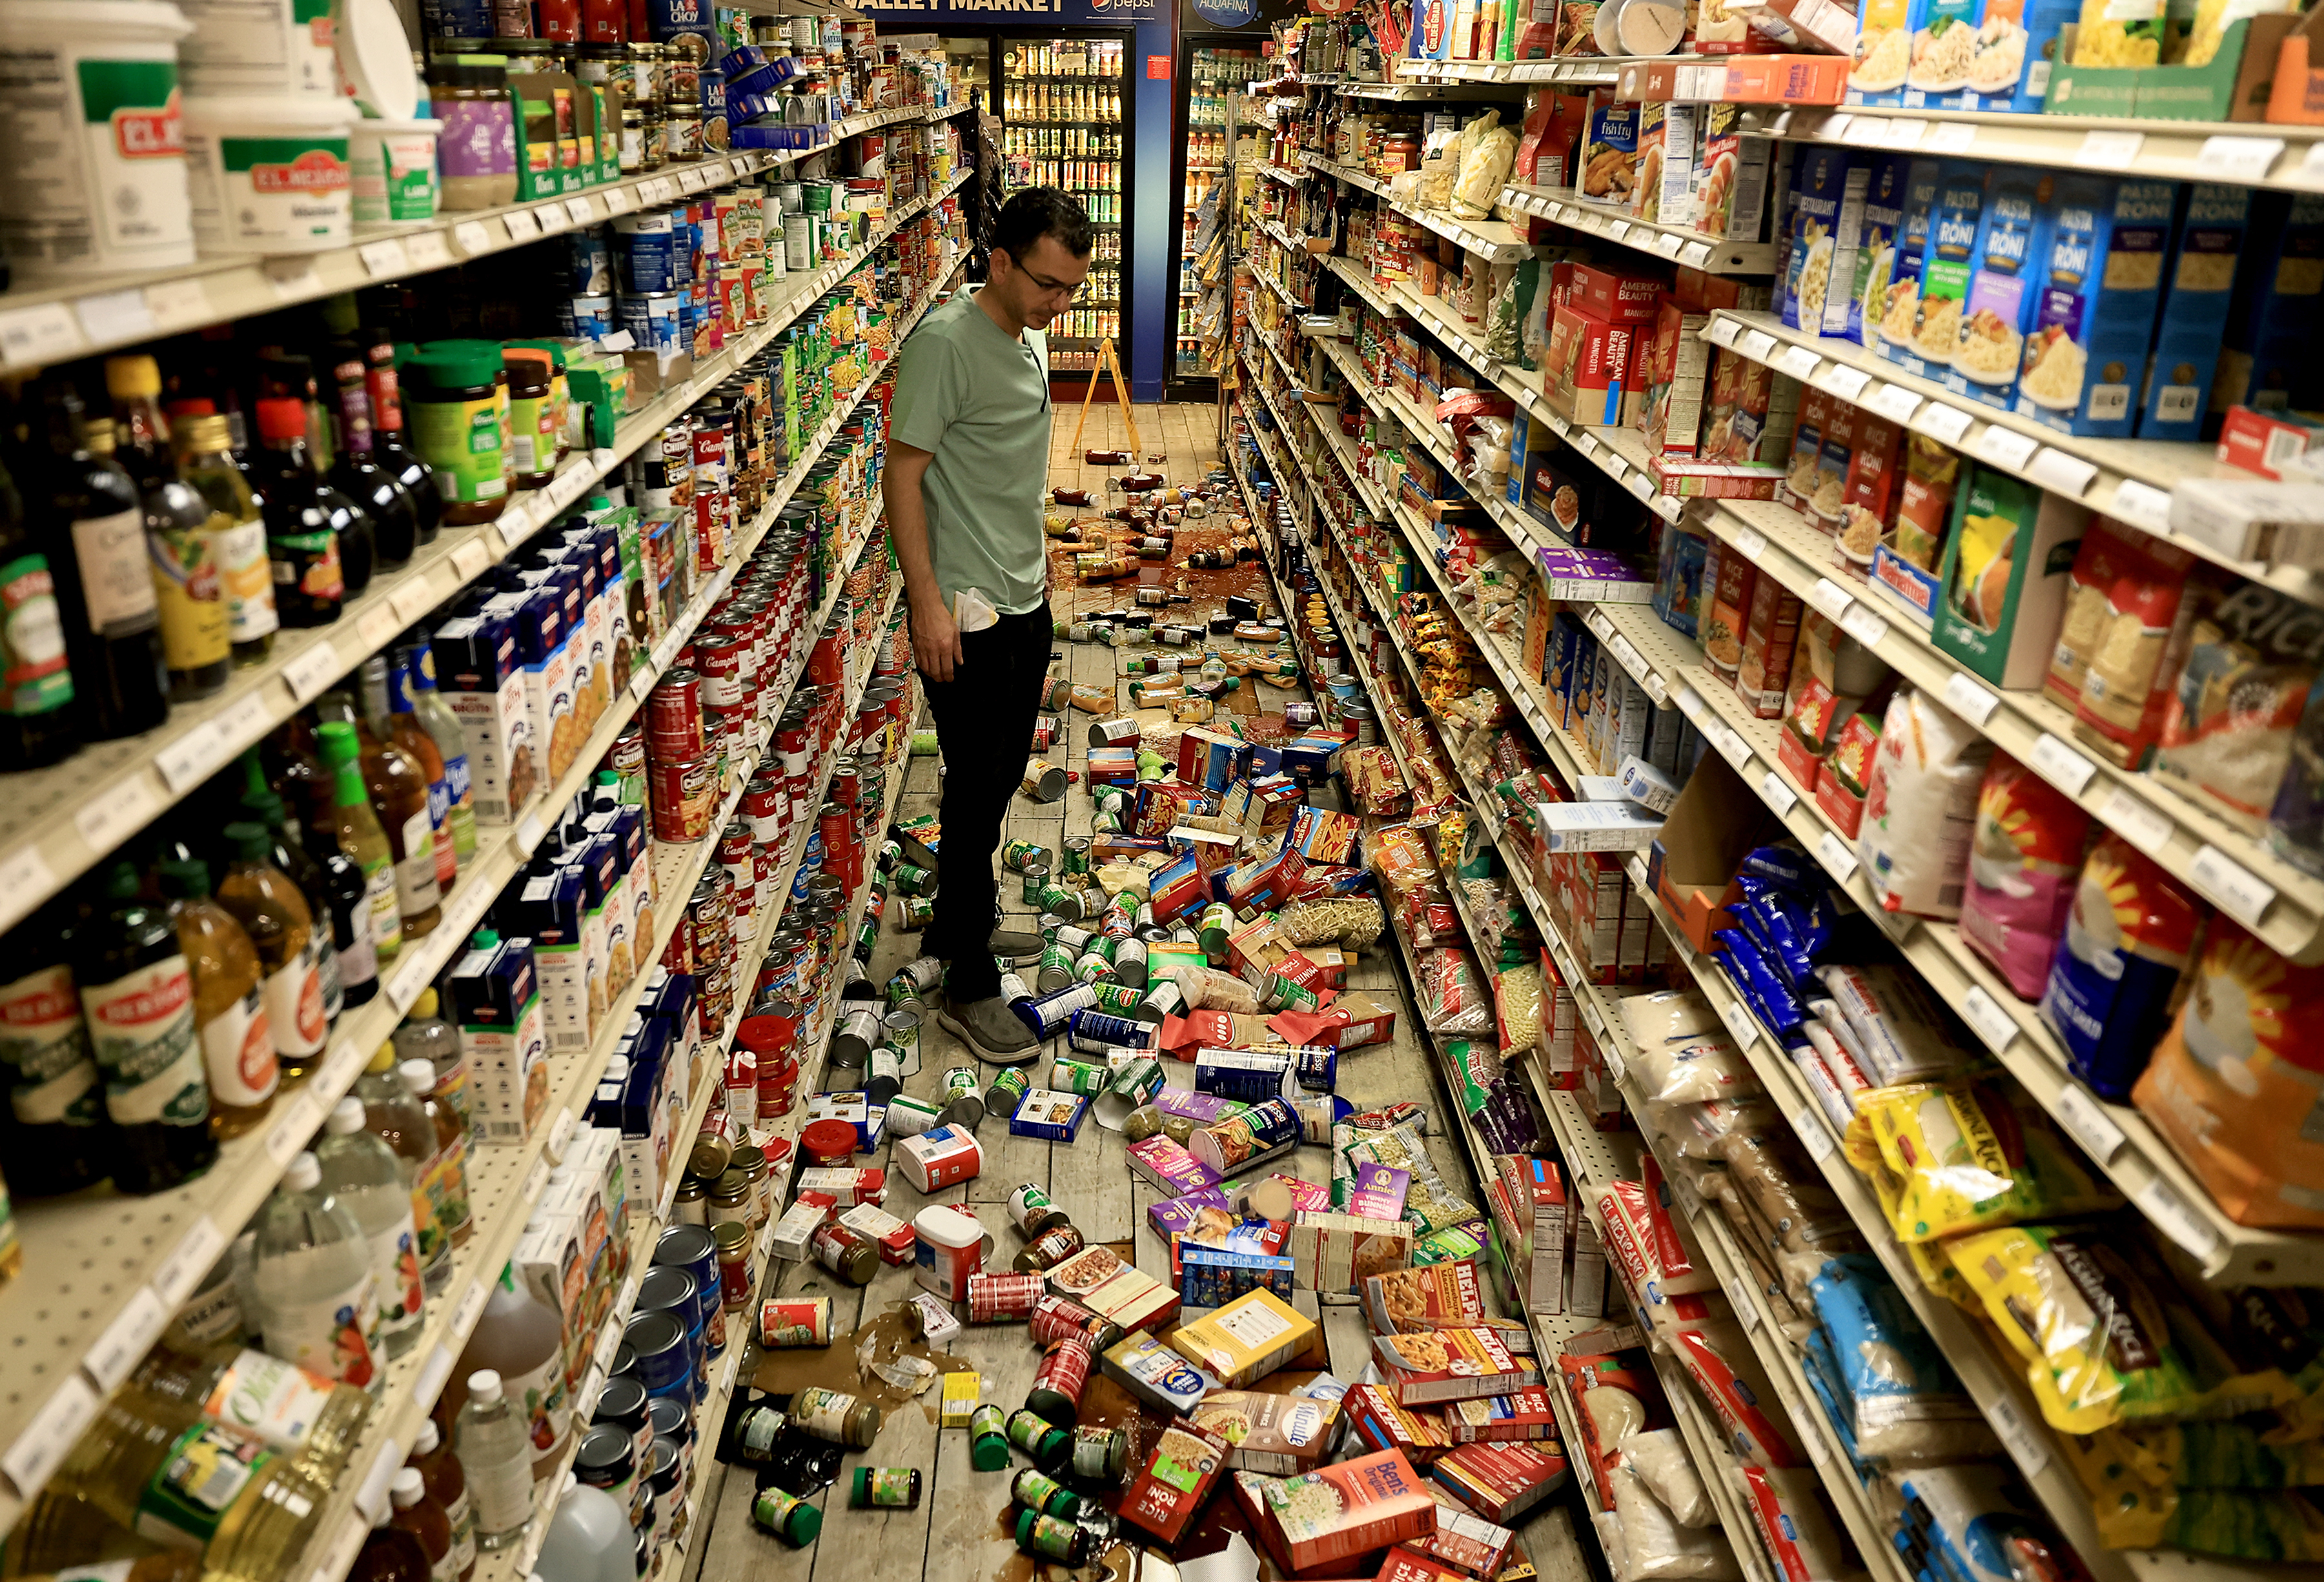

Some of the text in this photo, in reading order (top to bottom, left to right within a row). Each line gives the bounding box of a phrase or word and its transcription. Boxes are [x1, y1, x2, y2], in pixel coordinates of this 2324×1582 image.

[669, 1, 684, 11] LA
[950, 0, 1063, 12] MARKET
[1113, 0, 1154, 10] pepsi
[1198, 0, 1250, 14] AQUAFINA
[671, 10, 698, 23] CHOY
[1429, 1, 1442, 51] GOLDEN GRAIN
[708, 85, 719, 96] LA
[1602, 122, 1631, 139] fish fry
[1939, 222, 1975, 244] RONI
[1988, 232, 2025, 256] RONI
[2054, 245, 2086, 269] RONI
[1618, 290, 1655, 301] BEAUTY
[1588, 338, 1602, 375] MANICOTTI
[1606, 330, 1620, 367] BEAUTY
[1614, 330, 1629, 380] AMERICAN
[1859, 452, 1882, 472] RONI
[1726, 560, 1744, 578] RICE
[1721, 580, 1741, 599] RONI
[1294, 812, 1312, 849] GOLDEN GRAIN
[1258, 1110, 1274, 1130] CRUMBS
[1363, 1182, 1397, 1197] Annie's
[1365, 1194, 1391, 1205] YUMMY
[1358, 1199, 1394, 1215] BUNNIES
[1600, 1198, 1611, 1212] EL
[1606, 1215, 1646, 1279] MEXICANO
[1441, 1269, 1453, 1310] Macaroni
[1458, 1330, 1486, 1364] Three Cheese
[1471, 1327, 1514, 1371] HELPER
[1361, 1385, 1412, 1443] HELPER
[1513, 1394, 1531, 1414] RONI
[1530, 1393, 1547, 1414] RICE
[1290, 1401, 1320, 1447] Minute
[1363, 1466, 1393, 1501] Original
[1376, 1461, 1409, 1497] Ben's
[1147, 1482, 1177, 1508] RONI
[1138, 1499, 1169, 1523] RICE
